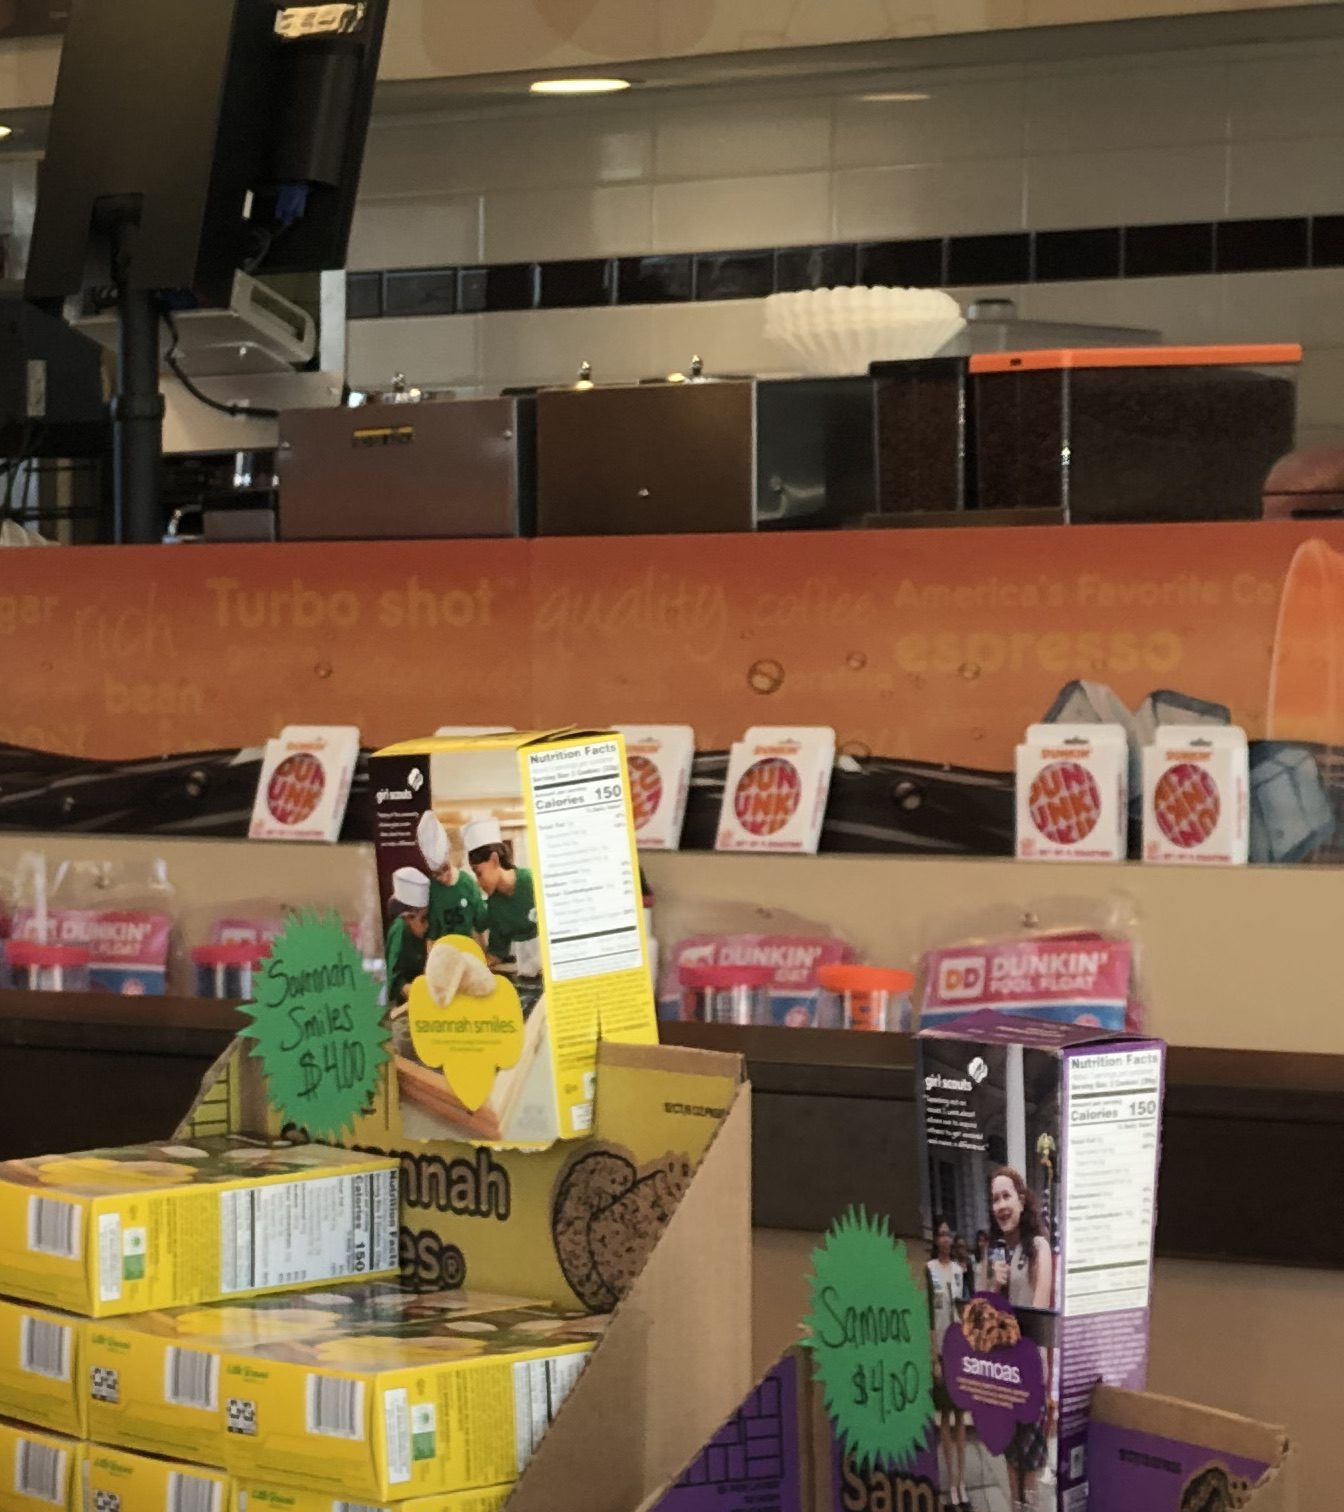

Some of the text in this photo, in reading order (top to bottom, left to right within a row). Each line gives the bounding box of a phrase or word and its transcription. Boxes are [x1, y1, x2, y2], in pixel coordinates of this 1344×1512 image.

[206, 577, 360, 628] Turbo
[893, 576, 1065, 609] America's
[1077, 573, 1214, 608] Favorite
[535, 566, 730, 662] quality
[894, 630, 1183, 674] espresso
[529, 743, 617, 766] Nutrition Facts
[535, 784, 623, 811] Calories 150
[718, 945, 822, 967] DUNKIN'
[943, 951, 1110, 989] DD DUNKIN'
[267, 951, 356, 1008] Savannah
[1043, 973, 1096, 992] FLOAT
[281, 1003, 354, 1052] Smiles
[415, 1016, 472, 1034] savannah
[1071, 1052, 1159, 1070] Nutrition Facts
[1071, 1101, 1157, 1122] Calories 150
[354, 1241, 365, 1273] 150
[820, 1285, 911, 1350] Samoas
[853, 1360, 920, 1423] $4.00
